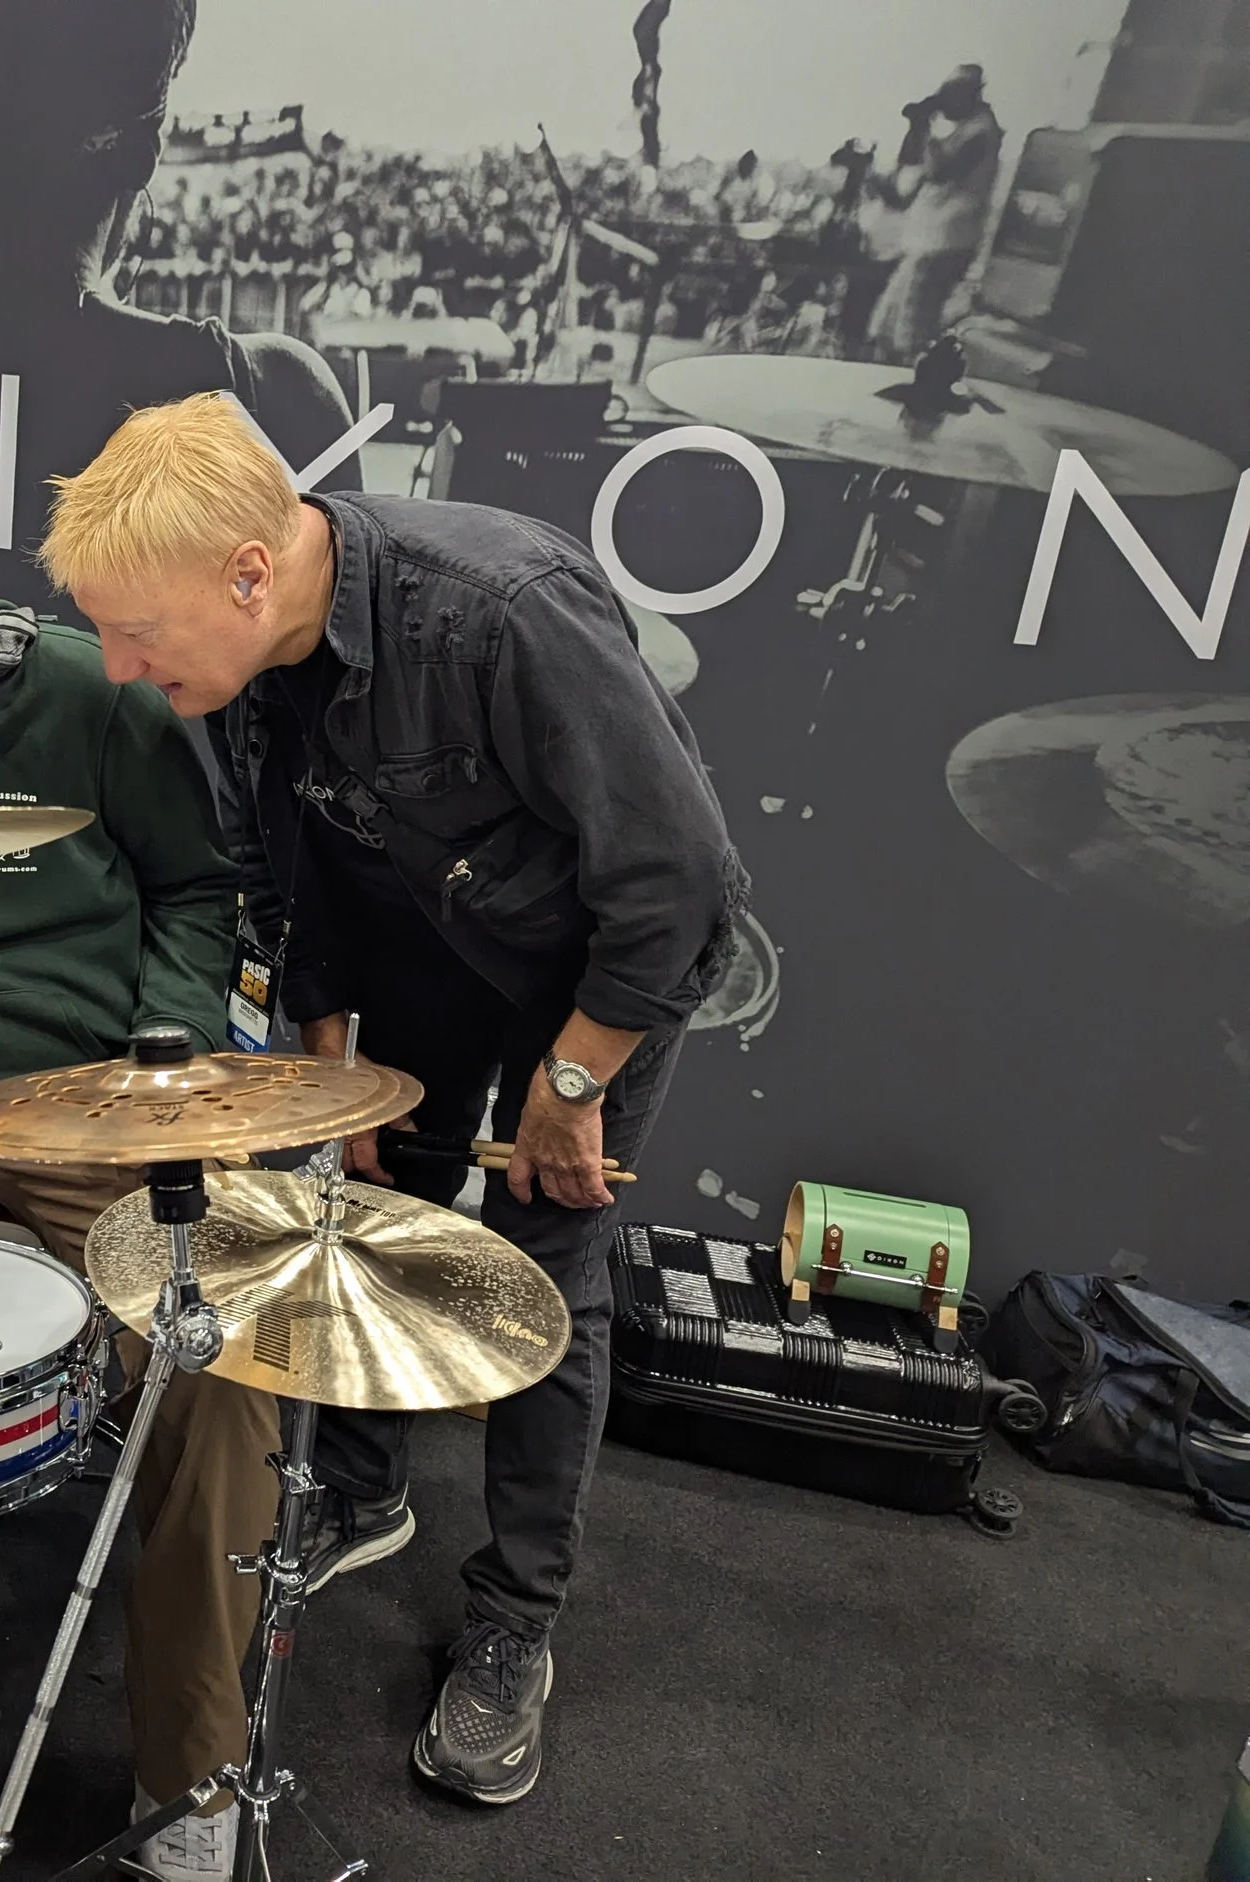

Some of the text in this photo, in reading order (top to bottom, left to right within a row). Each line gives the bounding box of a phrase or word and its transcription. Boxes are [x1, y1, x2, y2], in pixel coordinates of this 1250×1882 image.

[242, 958, 271, 986] PASIC
[239, 969, 268, 1007] 50
[233, 1030, 255, 1053] ARTIST
